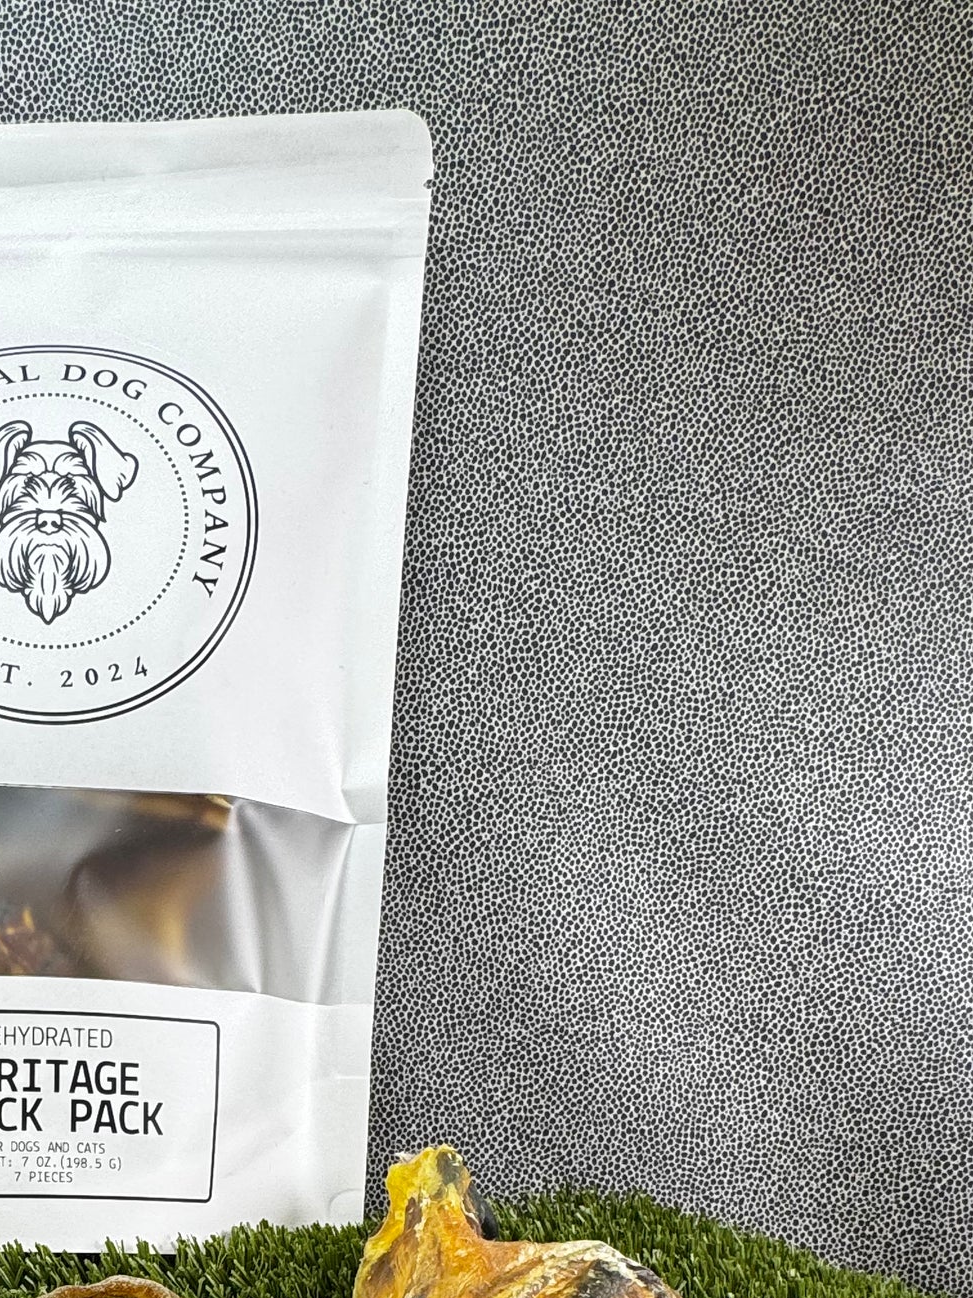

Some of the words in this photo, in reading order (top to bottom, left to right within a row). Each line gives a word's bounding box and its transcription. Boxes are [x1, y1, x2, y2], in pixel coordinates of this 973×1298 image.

[60, 363, 148, 401] DOG
[157, 402, 230, 598] COMPANY
[60, 656, 148, 688] 2024
[70, 1100, 163, 1136] PACK
[10, 1141, 40, 1153] DOGS
[47, 1142, 70, 1153] AND
[76, 1142, 106, 1154] CATS
[21, 1156, 28, 1167] 7
[14, 1171, 21, 1182] 7
[28, 1171, 74, 1183] PIECES
